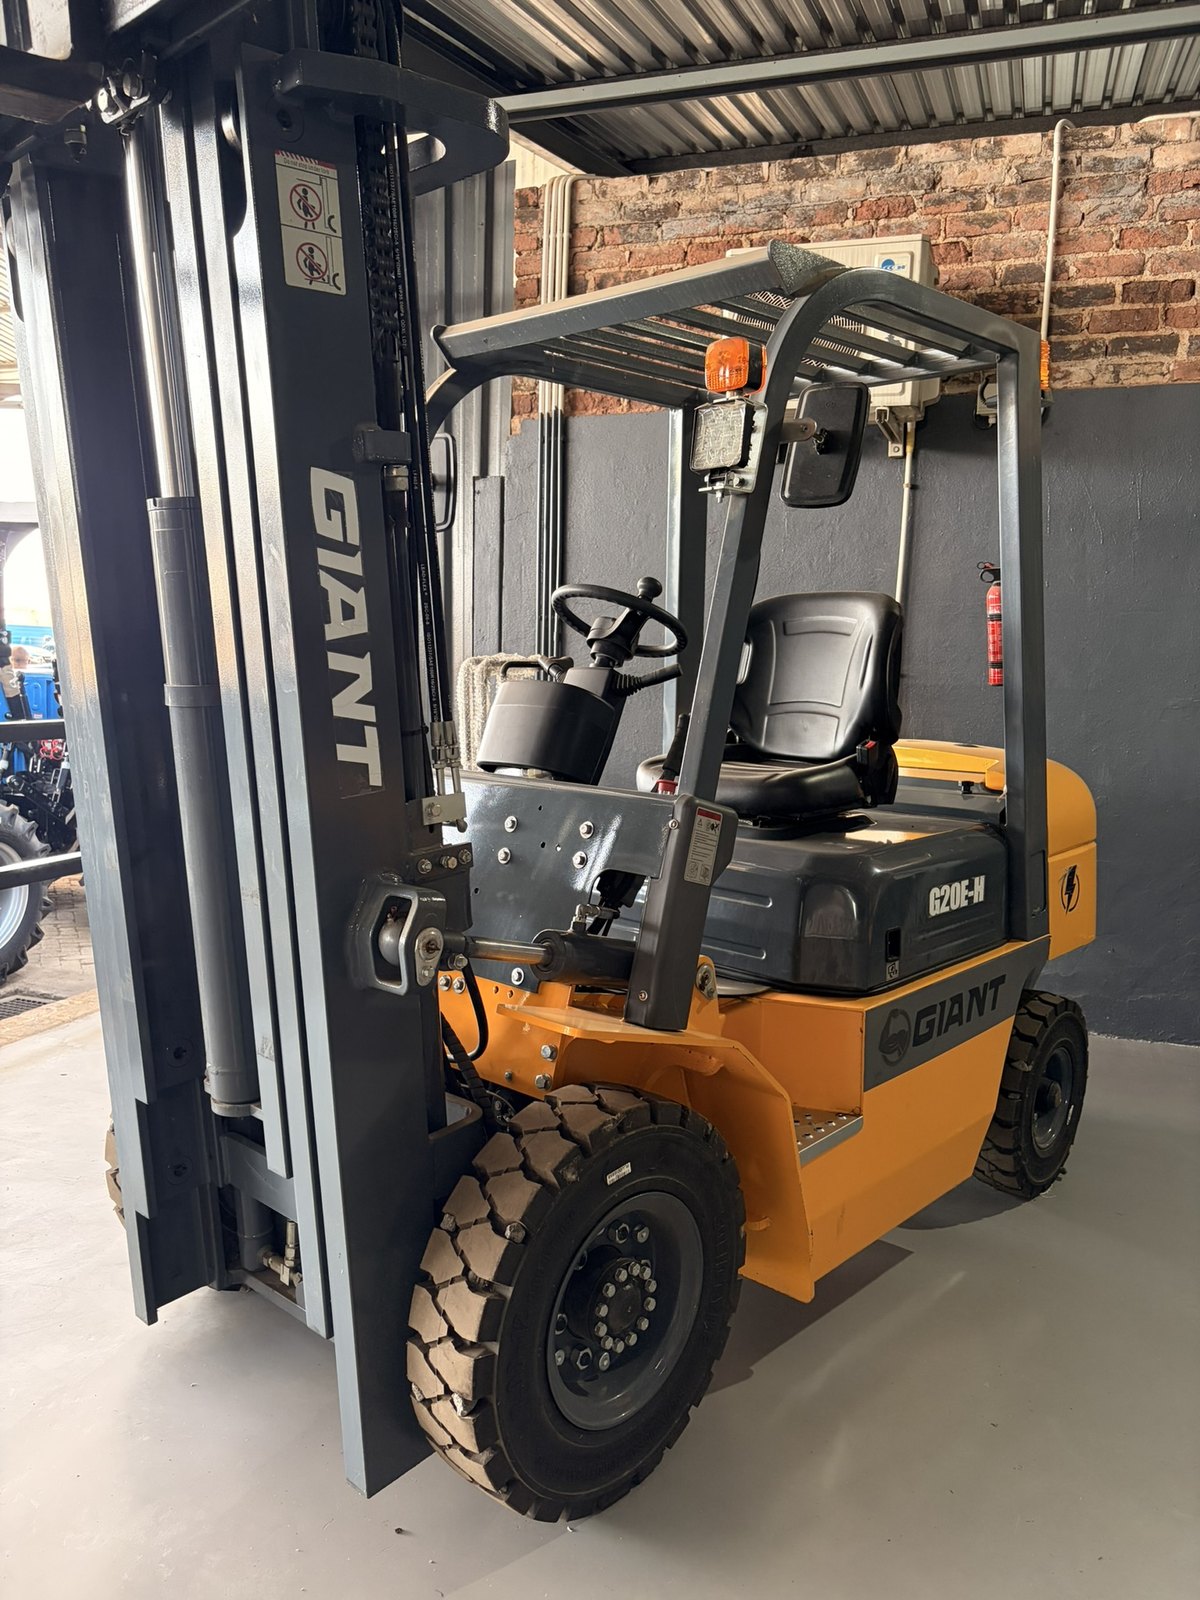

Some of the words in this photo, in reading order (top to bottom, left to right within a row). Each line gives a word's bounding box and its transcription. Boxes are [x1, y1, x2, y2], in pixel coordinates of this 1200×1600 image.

[310, 466, 383, 787] GIANT
[929, 875, 985, 916] G20E-H
[912, 974, 1007, 1047] GIANT
